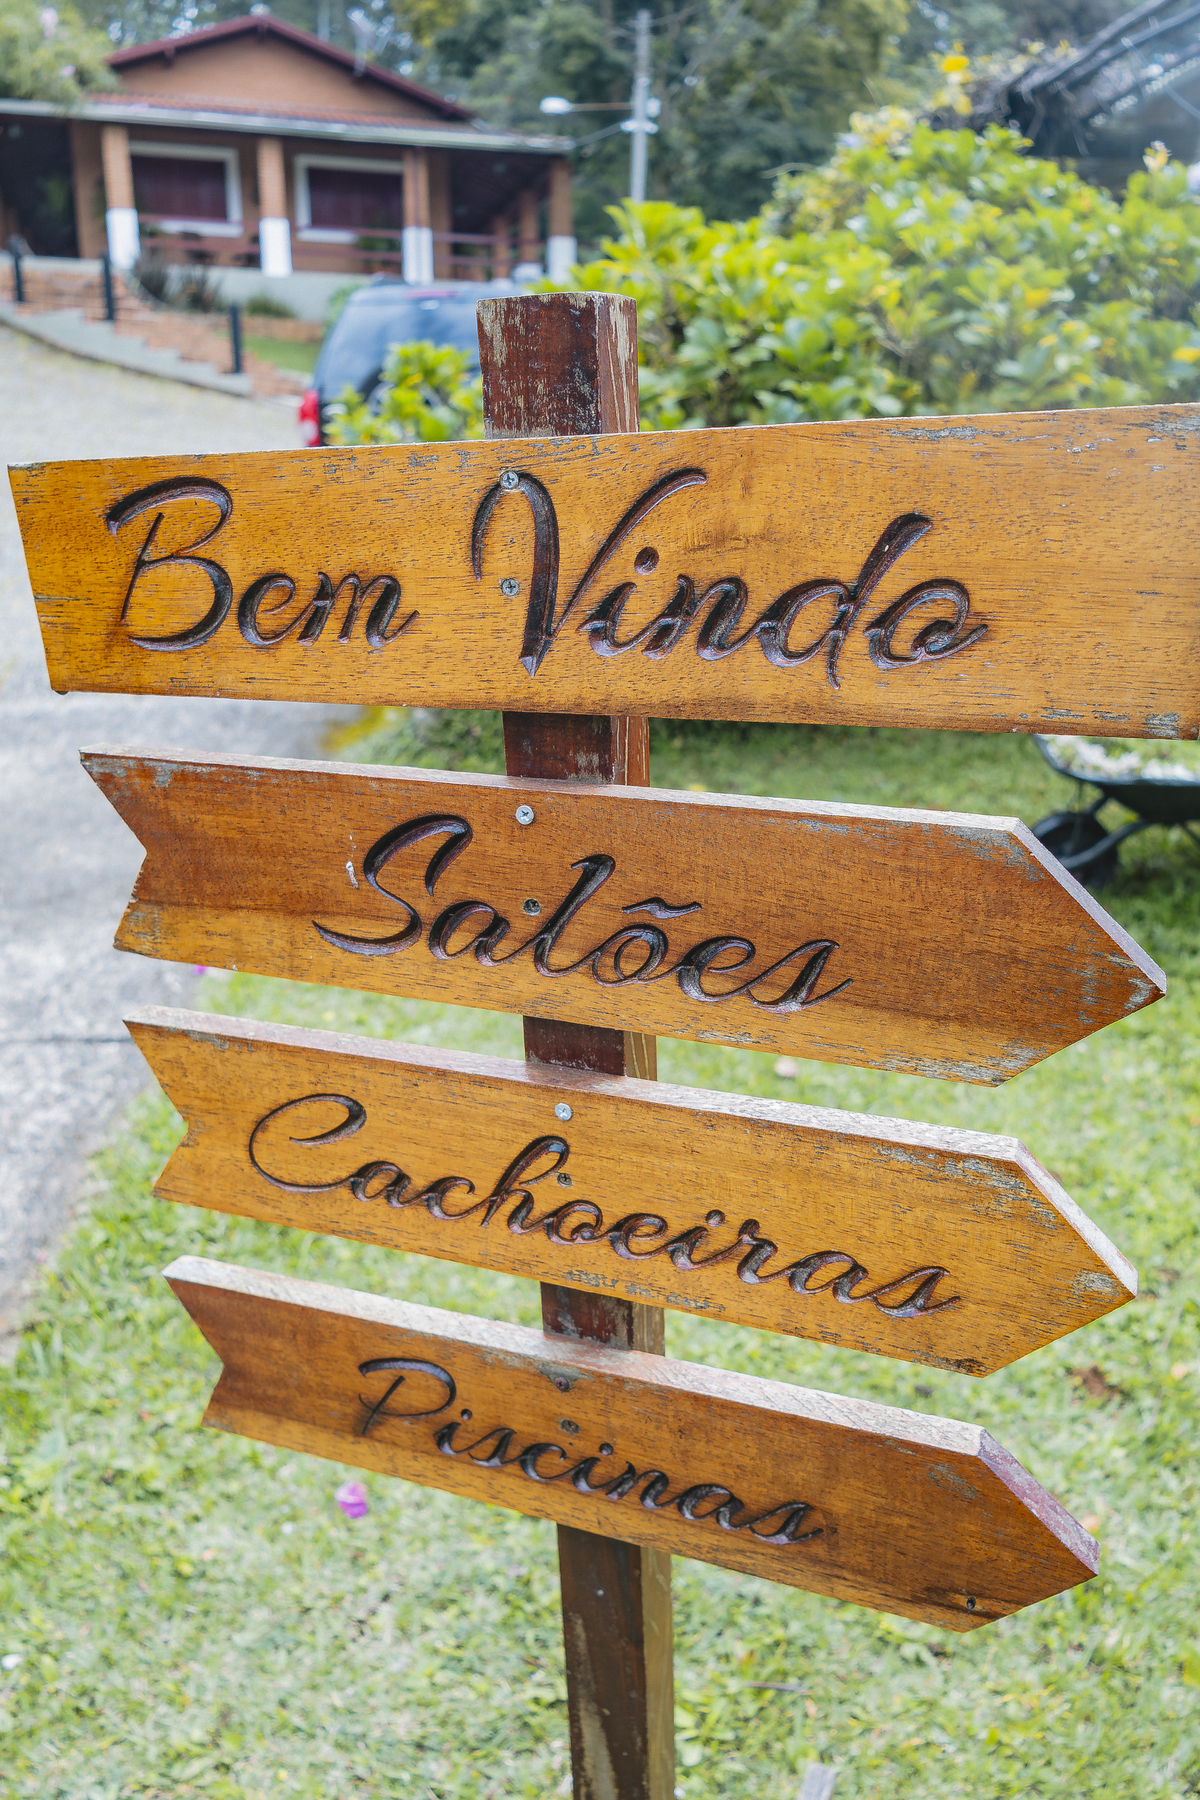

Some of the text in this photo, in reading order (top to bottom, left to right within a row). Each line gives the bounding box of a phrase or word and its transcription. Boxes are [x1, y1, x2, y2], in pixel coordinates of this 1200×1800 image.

[105, 465, 989, 690] Bem Vindo
[311, 813, 854, 1014] Salões
[248, 1092, 961, 1319] Cachoeiras
[357, 1356, 824, 1546] Piscinas
